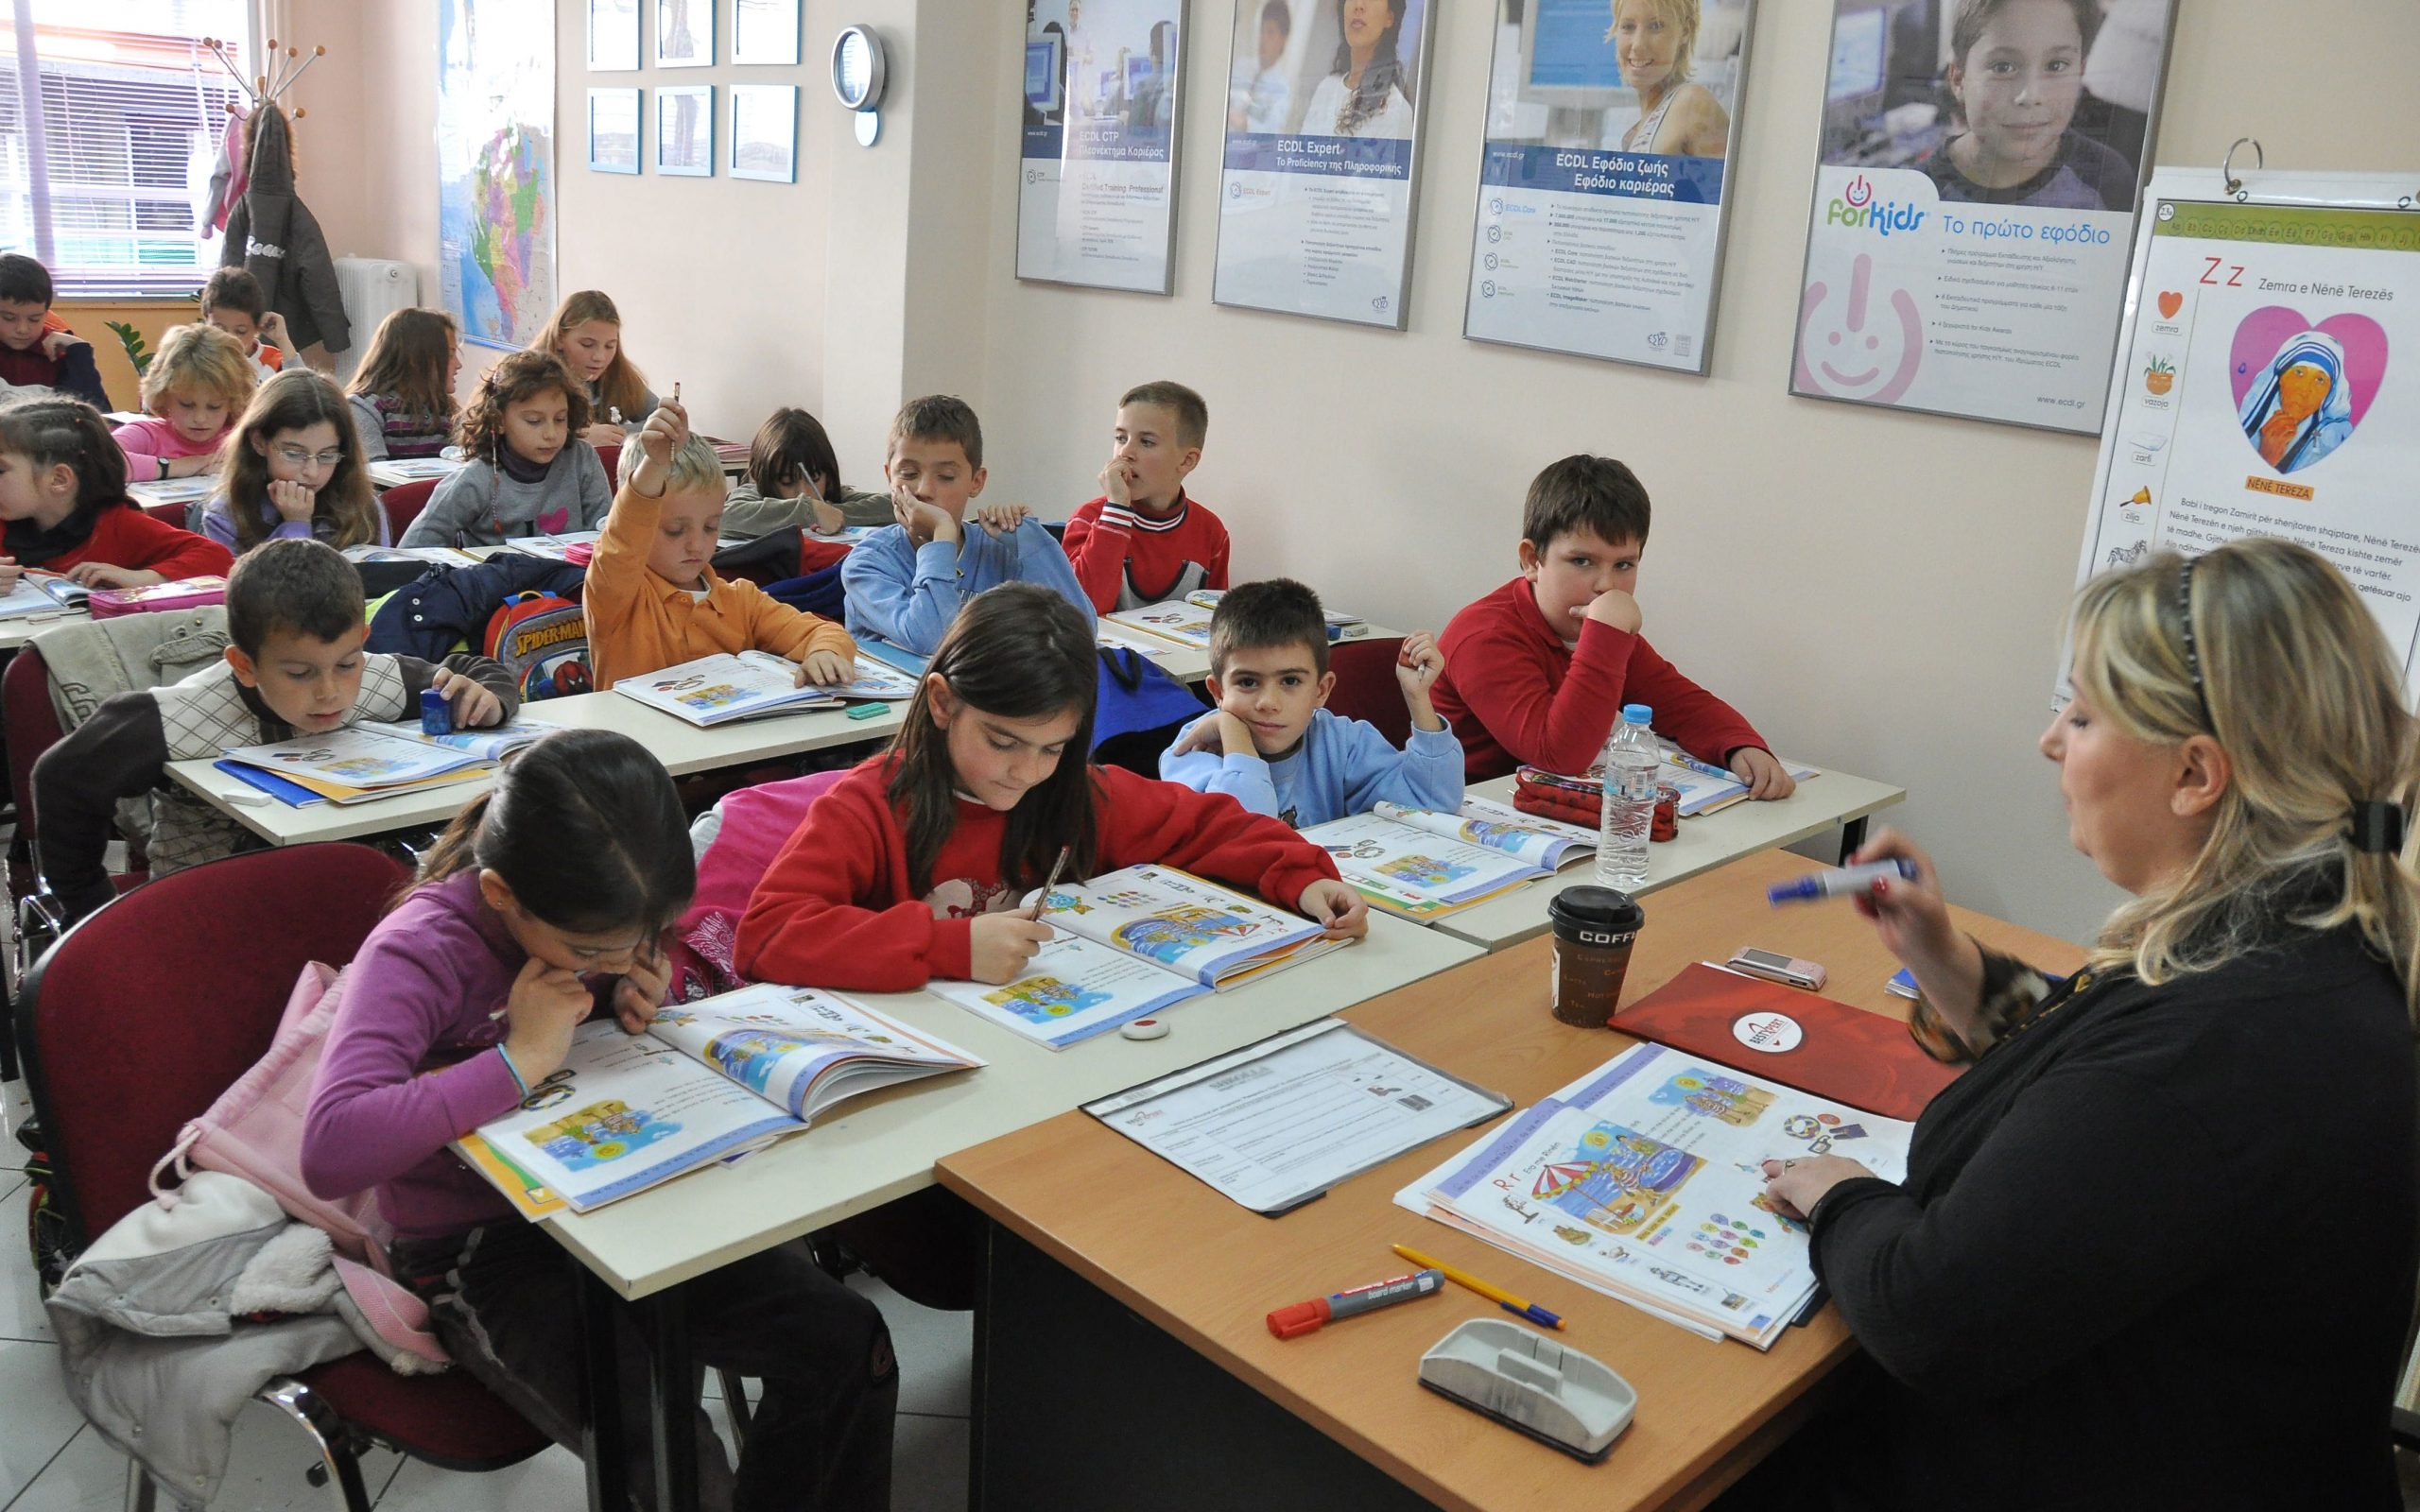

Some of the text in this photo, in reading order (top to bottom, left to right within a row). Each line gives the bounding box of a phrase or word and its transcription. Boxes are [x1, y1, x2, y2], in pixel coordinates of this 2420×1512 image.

[1080, 131, 1119, 142] ECDL CTP
[1277, 140, 1340, 157] ECDL Expert
[1287, 158, 1327, 171] Proficiency
[1329, 162, 1342, 171] της
[1343, 161, 1402, 176] Πληροφορικής
[1556, 154, 1668, 178] ECDL Εφόδιο ζωής
[1574, 174, 1675, 197] Εφόδιο καριέρας
[1972, 218, 2033, 240] πρώτο
[2041, 222, 2111, 247] εφόδιο
[2199, 256, 2245, 287] Z z
[2258, 278, 2394, 301] Zemra e Nënë Terezës
[2155, 324, 2179, 334] zemra
[2036, 396, 2085, 409] www.ecdl.gr
[2145, 398, 2169, 408] vazoja
[2247, 478, 2309, 499] NËNË TEREZA
[2181, 497, 2198, 508] Babi
[2204, 503, 2229, 515] tregon
[2229, 507, 2257, 521] Zamirit
[2273, 517, 2317, 533] shenjtoren
[2319, 527, 2360, 543] shqiptare,
[2363, 534, 2388, 547] Nënë
[2391, 539, 2420, 554] Terezë
[2169, 510, 2189, 522] Nënë
[2227, 524, 2244, 534] njeh
[2318, 541, 2345, 555] Tereza
[2347, 547, 2373, 560] kishte
[2375, 555, 2403, 567] zemër
[2175, 527, 2204, 541] madhe.
[2353, 565, 2361, 575] të
[2396, 592, 2411, 602] ajo
[1493, 1178, 1514, 1192] R
[1509, 1173, 1521, 1182] r
[1368, 1286, 1389, 1300] board
[1390, 1281, 1414, 1294] marker
